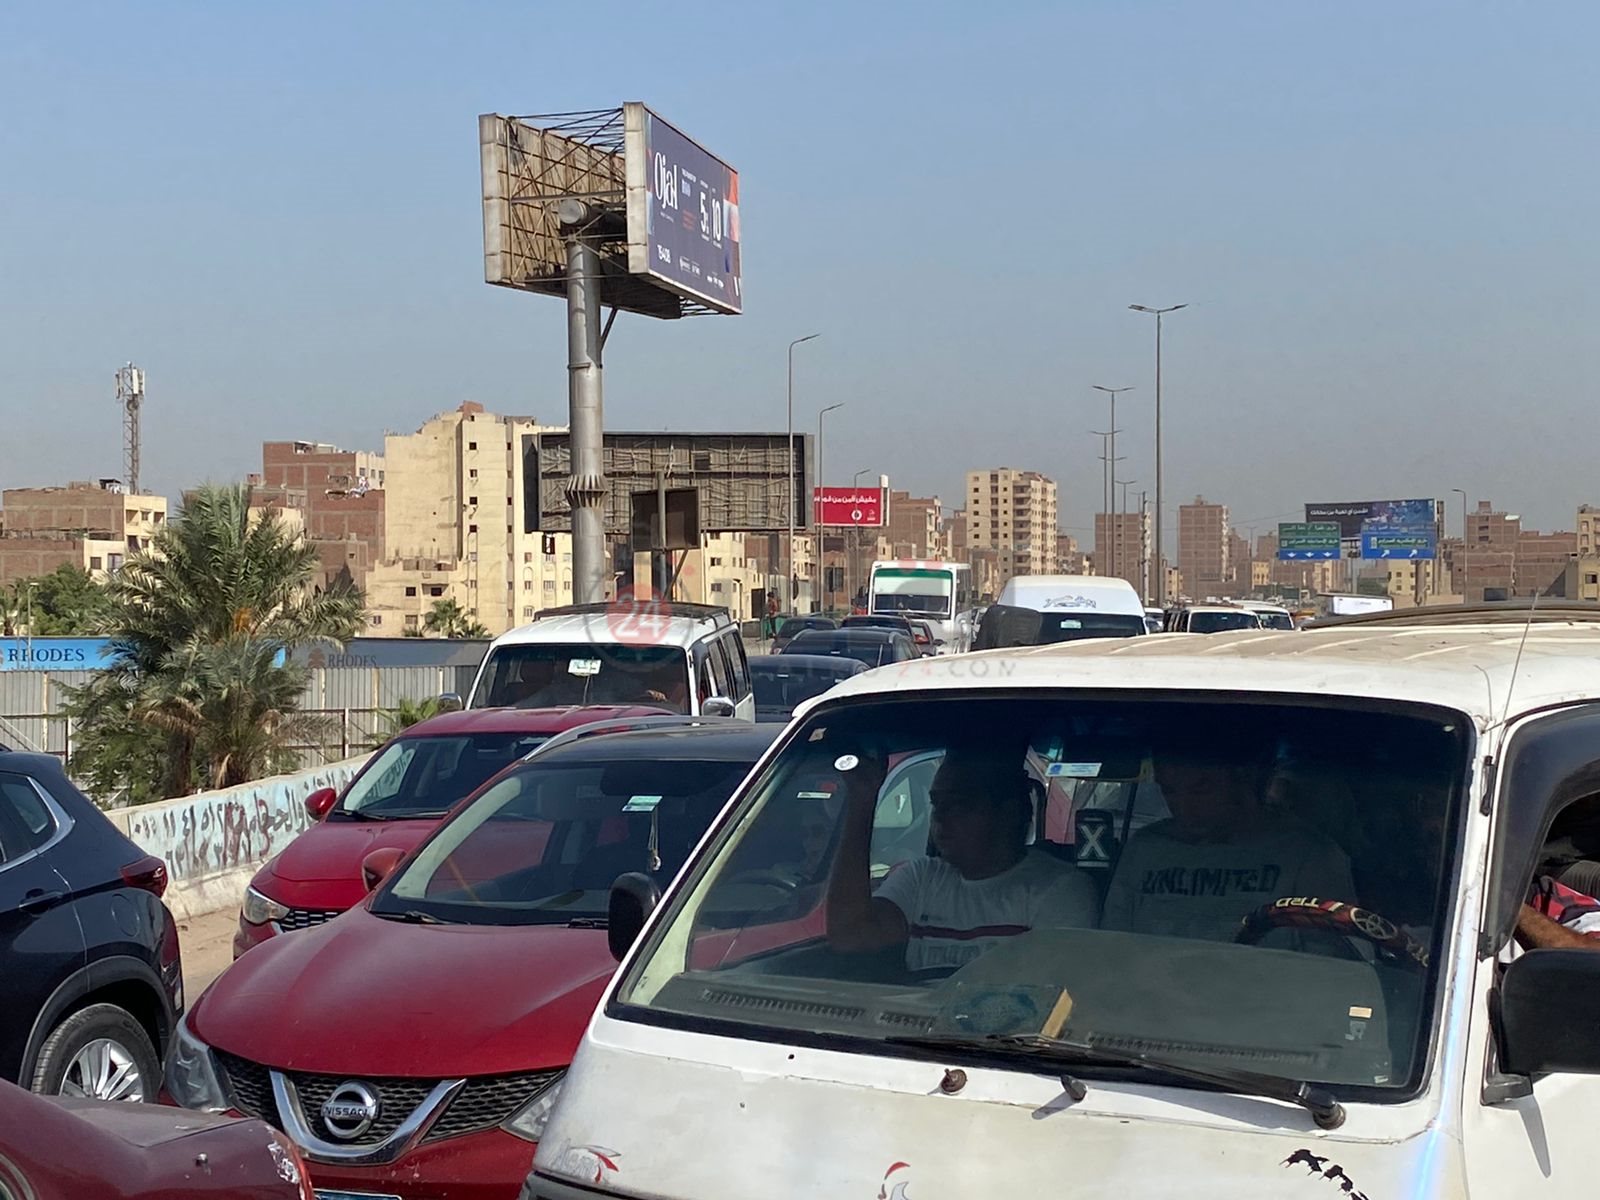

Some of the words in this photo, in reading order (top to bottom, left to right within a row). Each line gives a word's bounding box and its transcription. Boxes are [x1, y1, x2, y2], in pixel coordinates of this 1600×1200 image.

[655, 152, 678, 210] Ojal
[712, 198, 722, 241] 10
[8, 648, 85, 662] RHODES
[328, 654, 377, 668] RHODES
[1078, 824, 1110, 859] X
[1141, 864, 1281, 897] UNLIMITED
[1276, 896, 1320, 908] TRD
[325, 1106, 368, 1118] NISSAN
